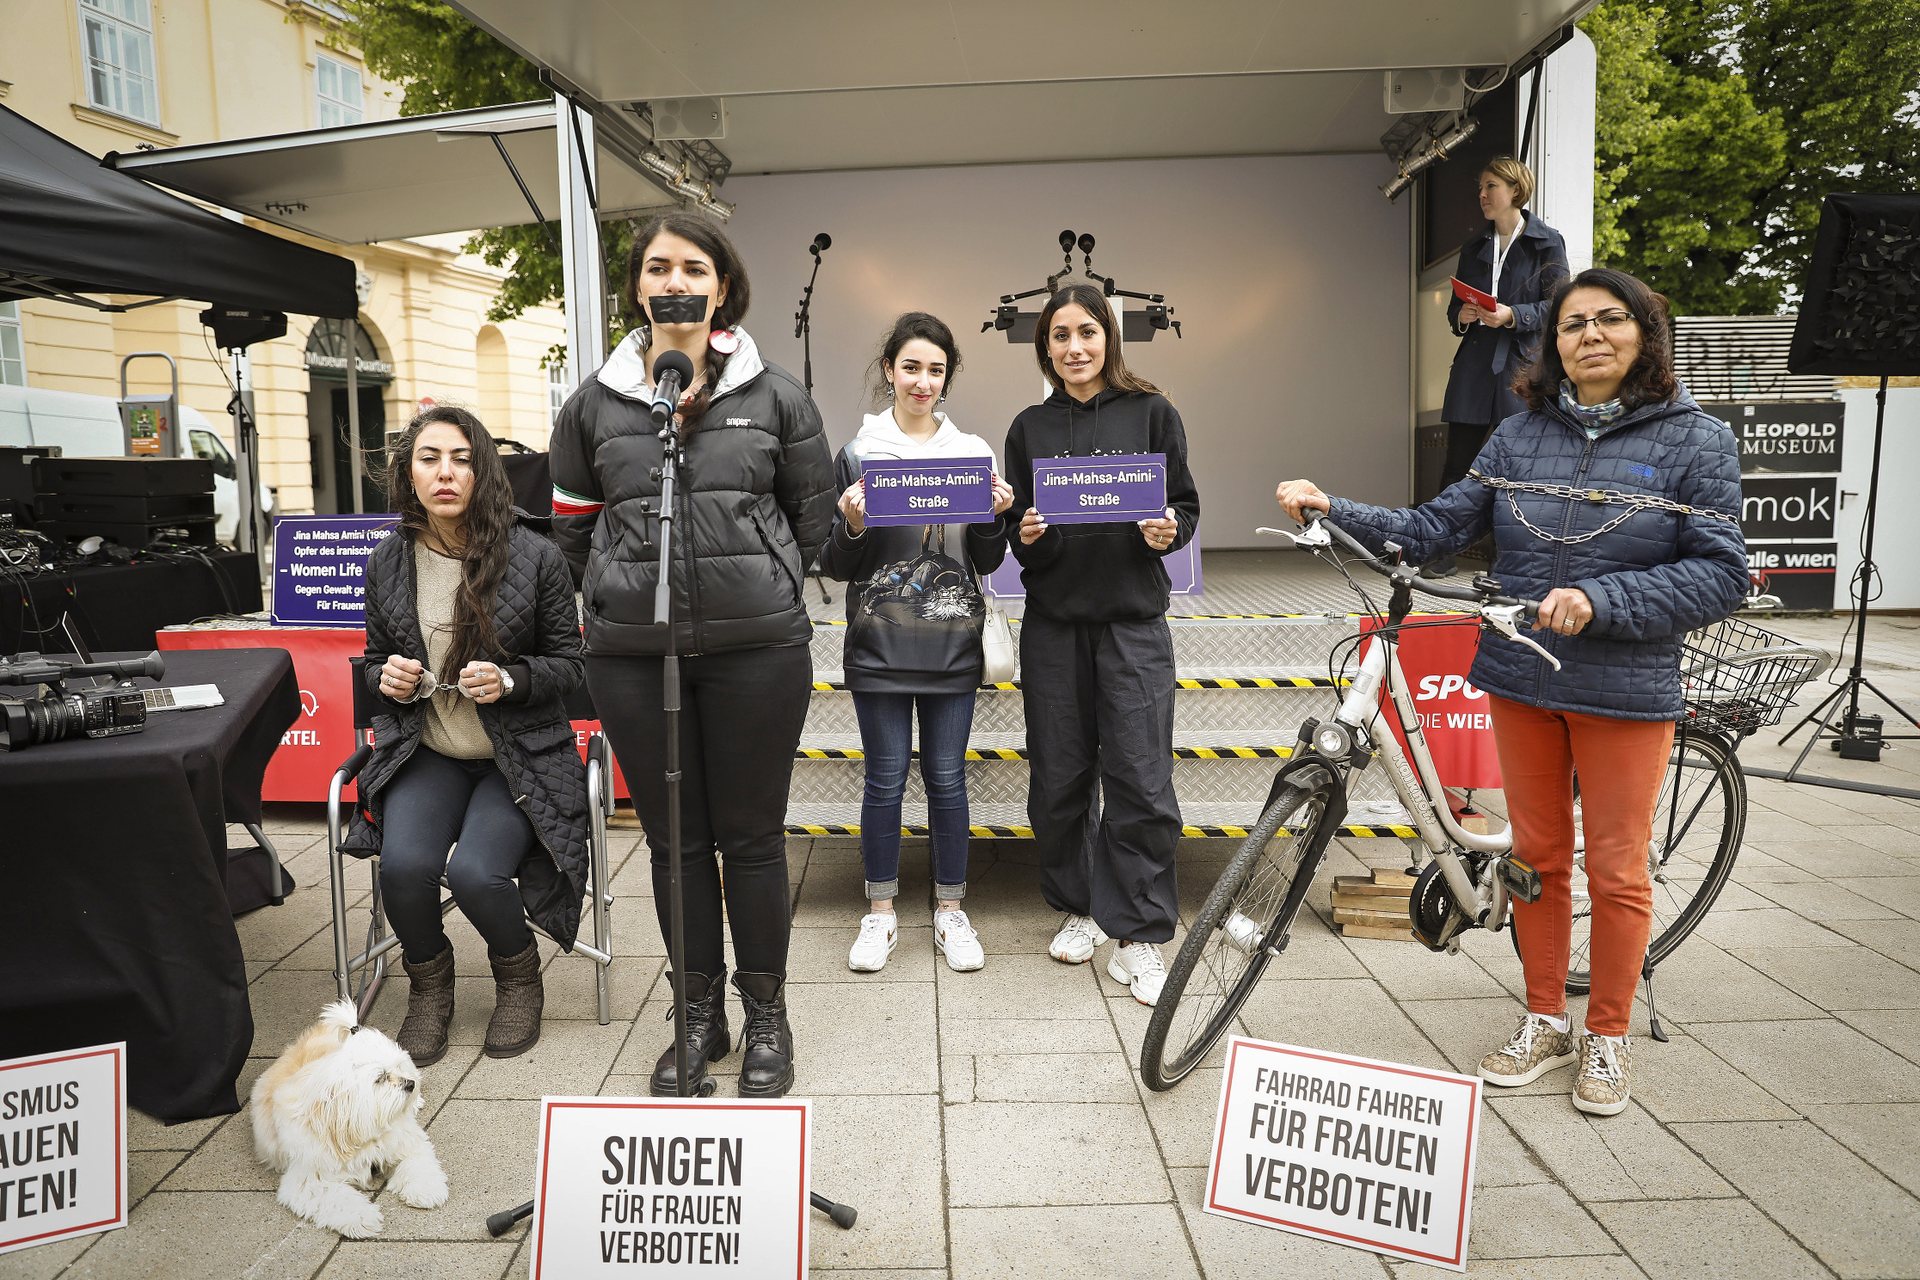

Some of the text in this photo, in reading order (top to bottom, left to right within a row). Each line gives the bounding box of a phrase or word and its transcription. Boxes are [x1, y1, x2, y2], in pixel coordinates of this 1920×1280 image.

[1743, 423, 1836, 438] LEOPOLD
[1742, 438, 1836, 455] MUSEUM
[872, 472, 984, 488] Jina-Mahsa-Amini-
[1042, 469, 1157, 486] Jina-Mahsa-Amini-
[909, 495, 949, 509] Straße
[1079, 493, 1120, 506] Straße
[1741, 487, 1831, 522] mok
[293, 530, 310, 540] Jina
[312, 530, 340, 540] Mahsa
[341, 530, 365, 540] Amini
[294, 546, 319, 557] Opfer
[320, 546, 335, 555] des
[1784, 552, 1836, 567] wien
[291, 563, 336, 576] Women
[339, 562, 363, 576] Life
[295, 585, 321, 596] Gegen
[323, 585, 353, 594] Gewalt
[317, 600, 331, 610] Für
[1416, 713, 1442, 728] DIE
[2, 1080, 79, 1121] SMUS
[1255, 1067, 1443, 1126] FAHRRAD FAHREN
[1249, 1099, 1438, 1176] FÜR FRAUEN
[601, 1135, 743, 1186] SINGEN
[0, 1168, 77, 1222] TEN!
[1245, 1153, 1432, 1235] VERBOTEN!
[601, 1189, 742, 1225] FÜR FRAUEN
[600, 1231, 740, 1265] VERBOTEN!
